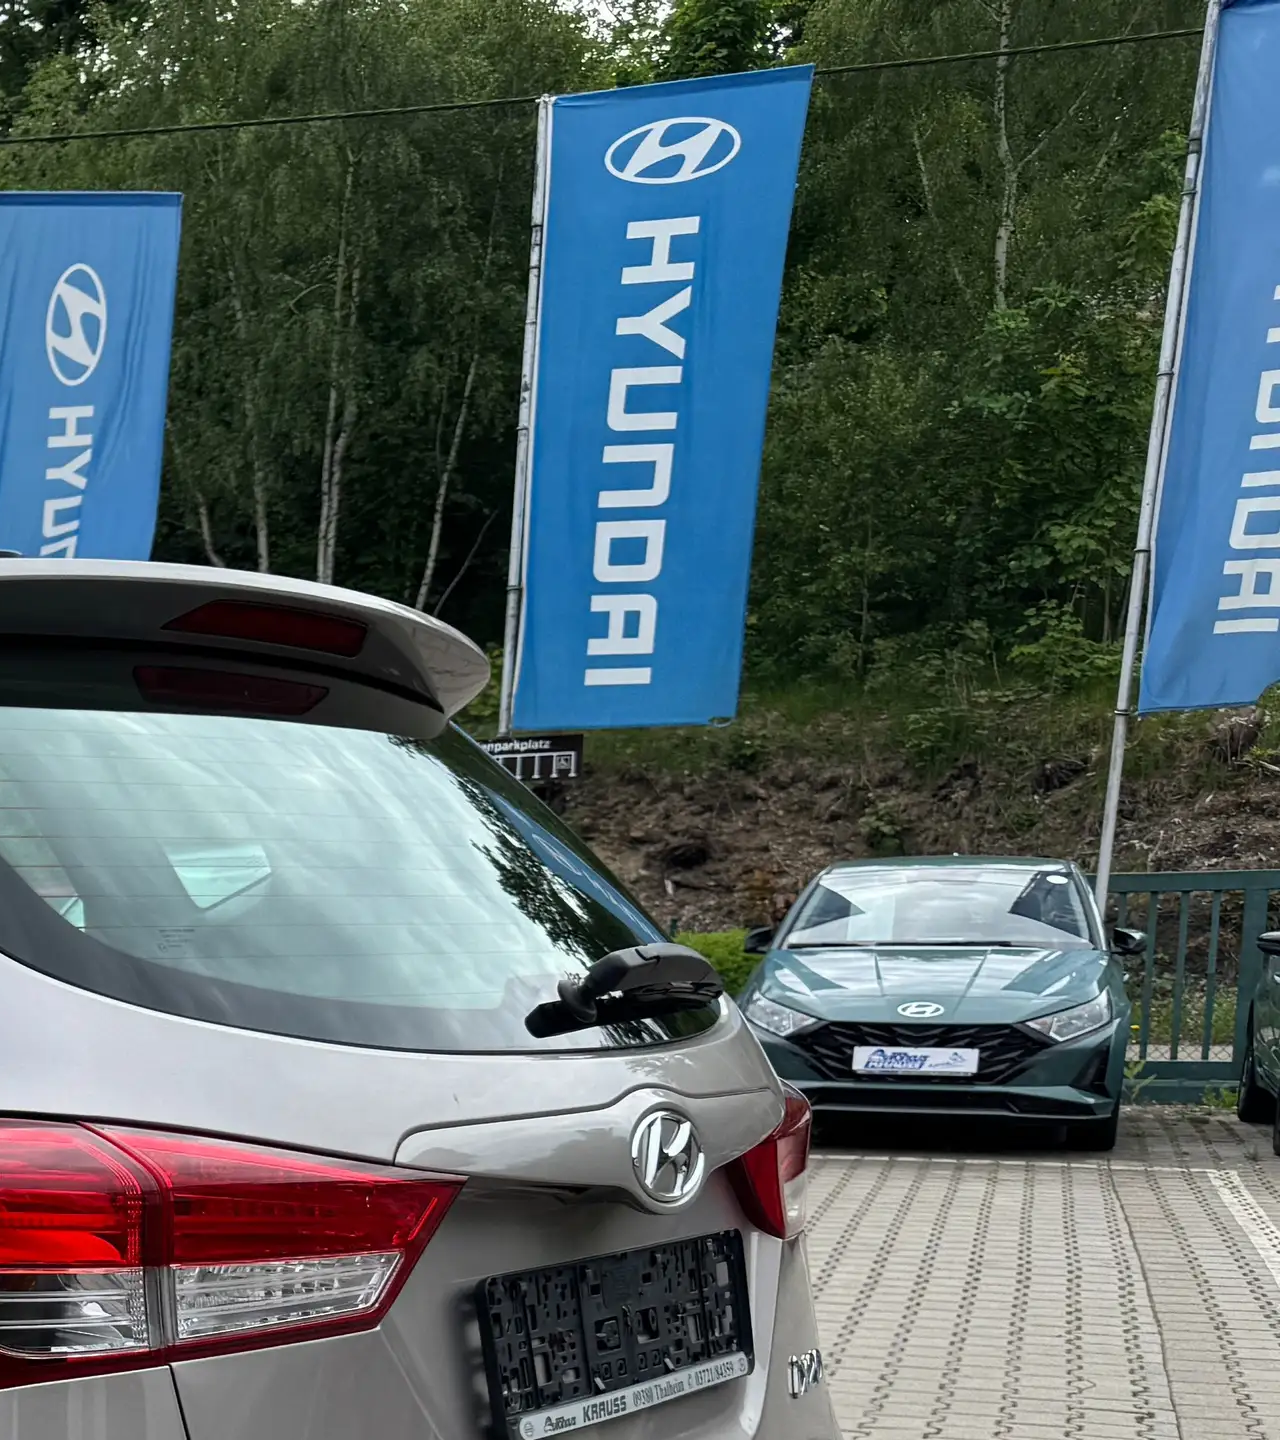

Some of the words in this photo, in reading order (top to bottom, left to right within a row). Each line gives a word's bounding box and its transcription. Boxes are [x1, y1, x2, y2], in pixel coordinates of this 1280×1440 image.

[584, 215, 700, 686] HYUNDAI
[583, 1394, 627, 1423] KRAUSS
[654, 1378, 685, 1400] Thalheim
